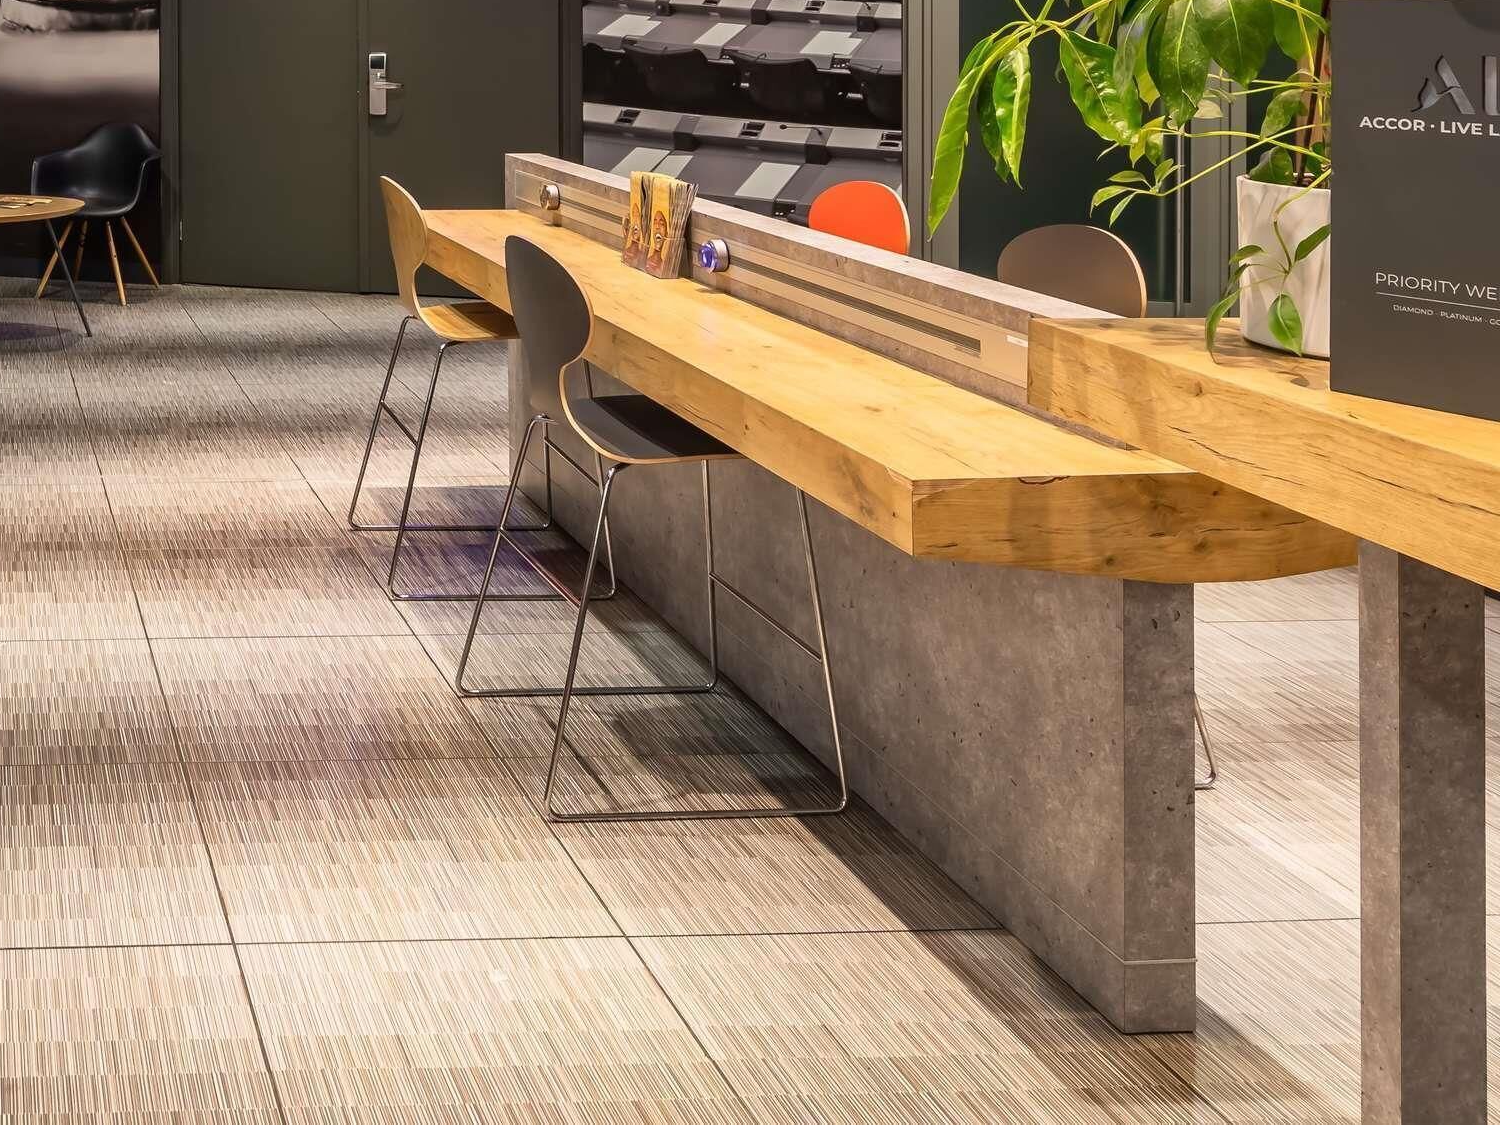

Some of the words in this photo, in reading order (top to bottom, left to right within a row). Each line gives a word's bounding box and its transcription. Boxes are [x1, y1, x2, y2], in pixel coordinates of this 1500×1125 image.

[1359, 116, 1426, 132] ACCOR
[1440, 121, 1483, 135] LIVE
[1375, 272, 1460, 295] PRIORITY
[1465, 283, 1498, 301] WE
[1393, 304, 1434, 316] DIAMOND
[1440, 310, 1483, 323] PLATINUM
